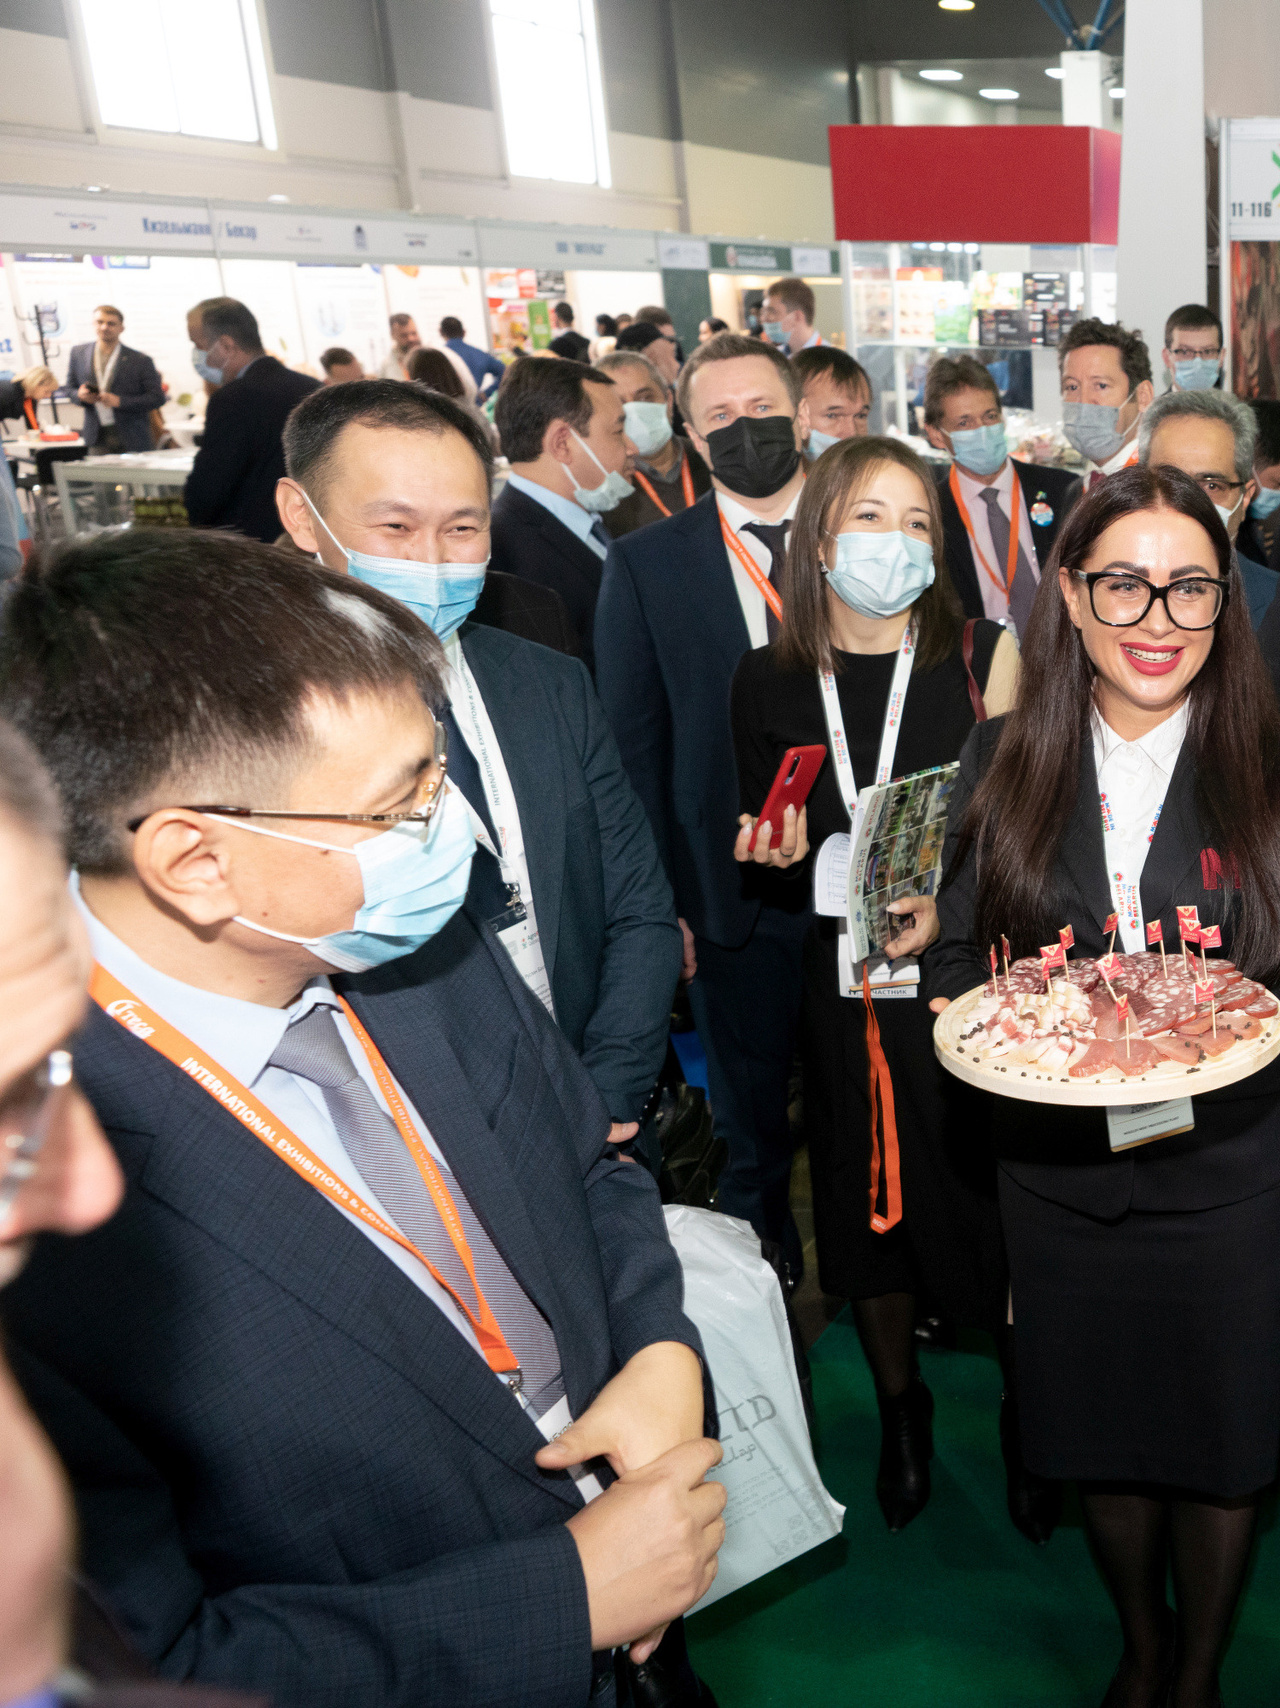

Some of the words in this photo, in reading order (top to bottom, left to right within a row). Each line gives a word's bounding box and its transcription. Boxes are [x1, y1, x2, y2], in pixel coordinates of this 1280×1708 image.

[1231, 202, 1272, 217] 11-116
[481, 747, 500, 806] INTERNATIONAL
[869, 988, 907, 996] ЧАСТНИК
[180, 1056, 276, 1143] INTERNATIONAL
[276, 1138, 349, 1201] EXHIBITIONS
